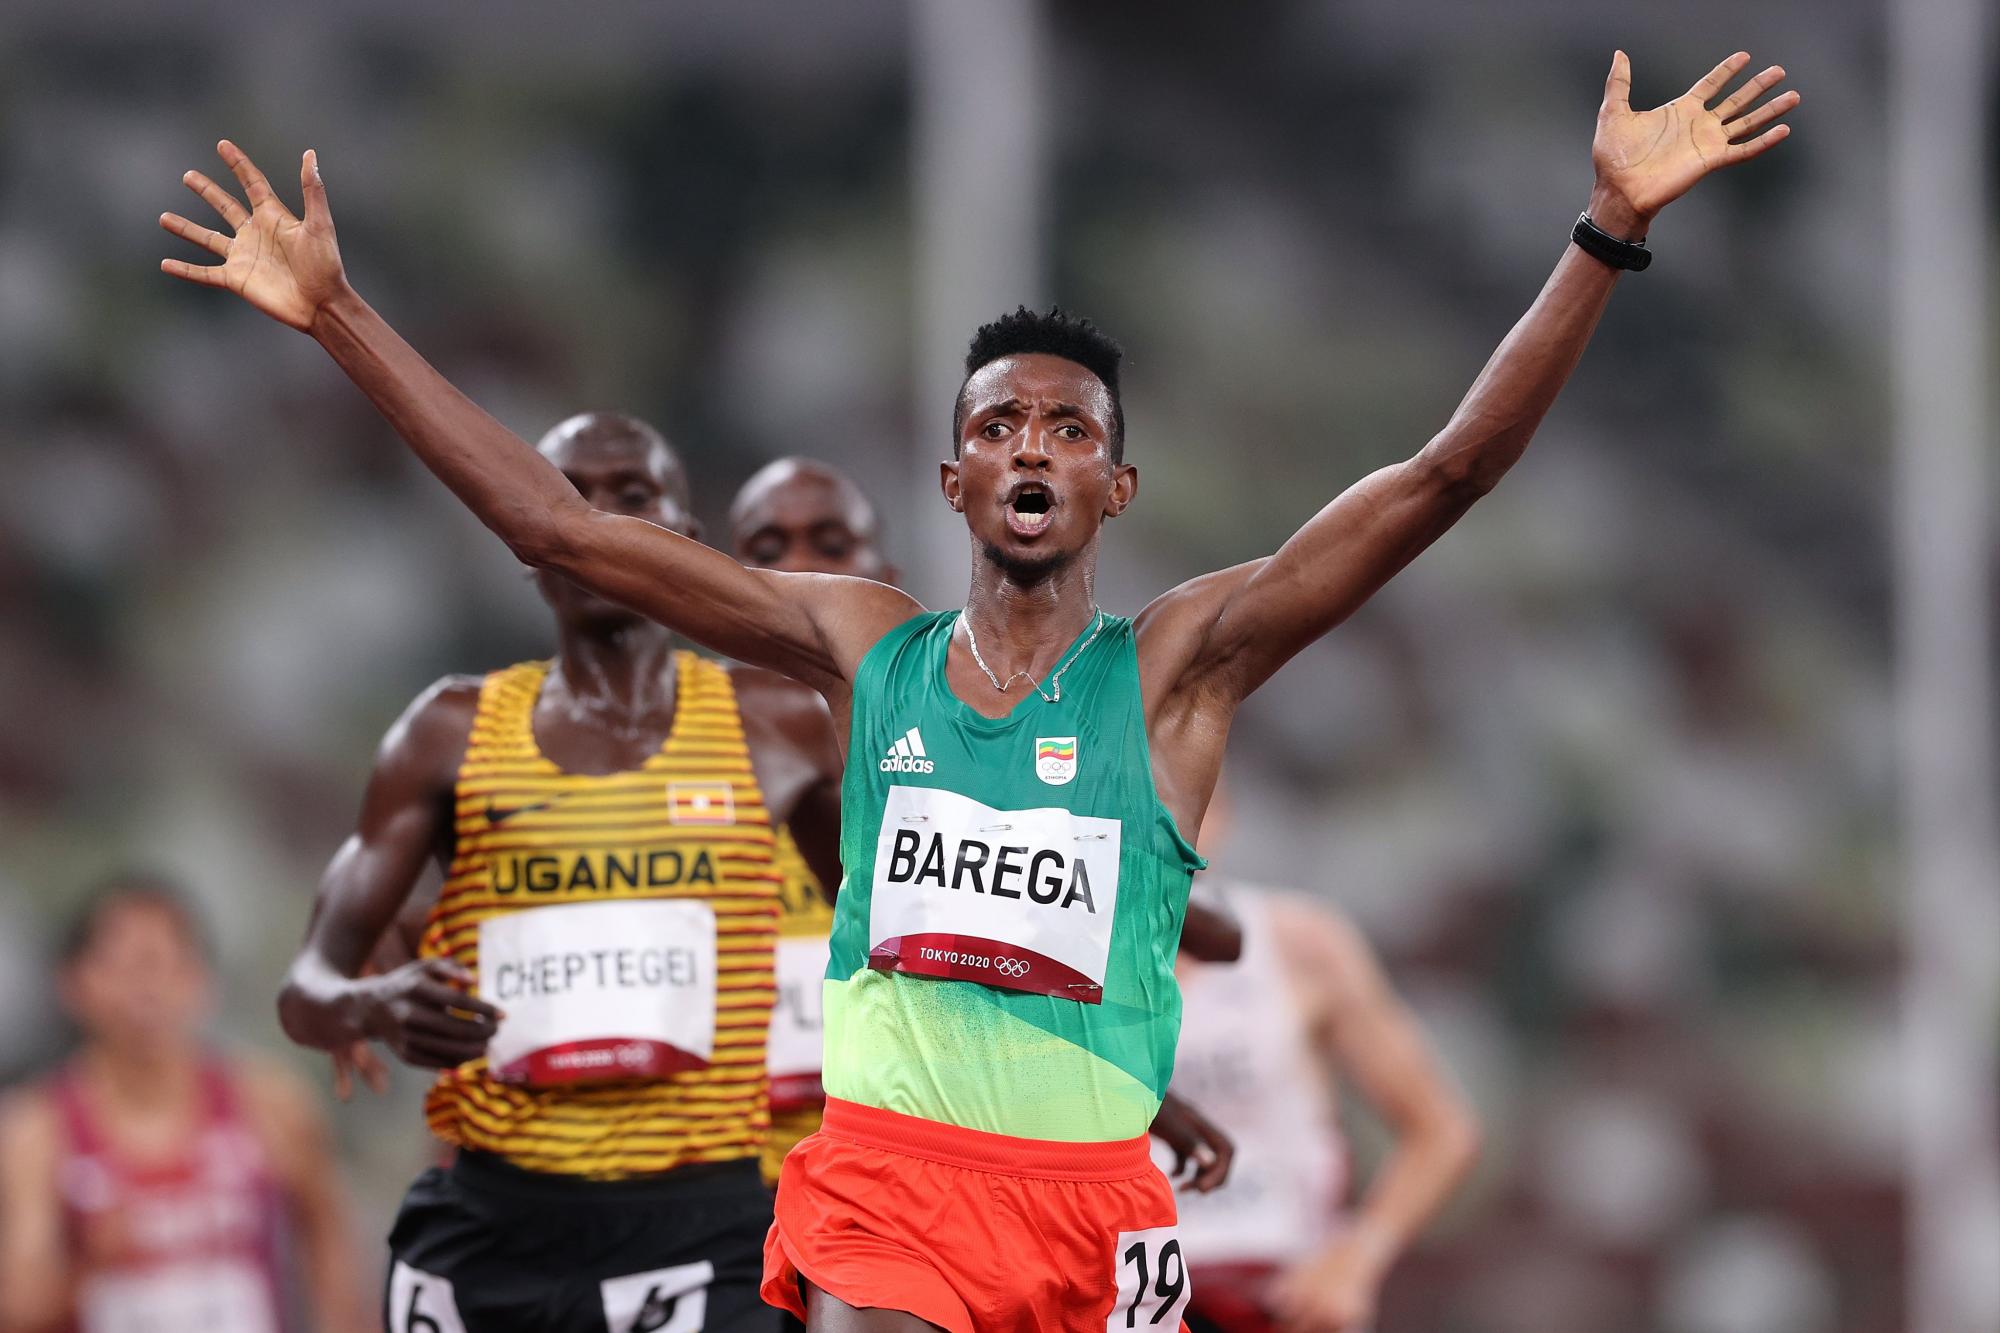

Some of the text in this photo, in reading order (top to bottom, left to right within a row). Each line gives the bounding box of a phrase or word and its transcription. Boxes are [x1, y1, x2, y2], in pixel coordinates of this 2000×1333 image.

[880, 754, 934, 774] adidas
[494, 850, 716, 894] UGANDA
[888, 828, 1096, 914] BAREGA
[496, 947, 698, 1000] CHEPTEGEI
[920, 947, 990, 969] TOKYO 2020
[1125, 1239, 1184, 1328] 19
